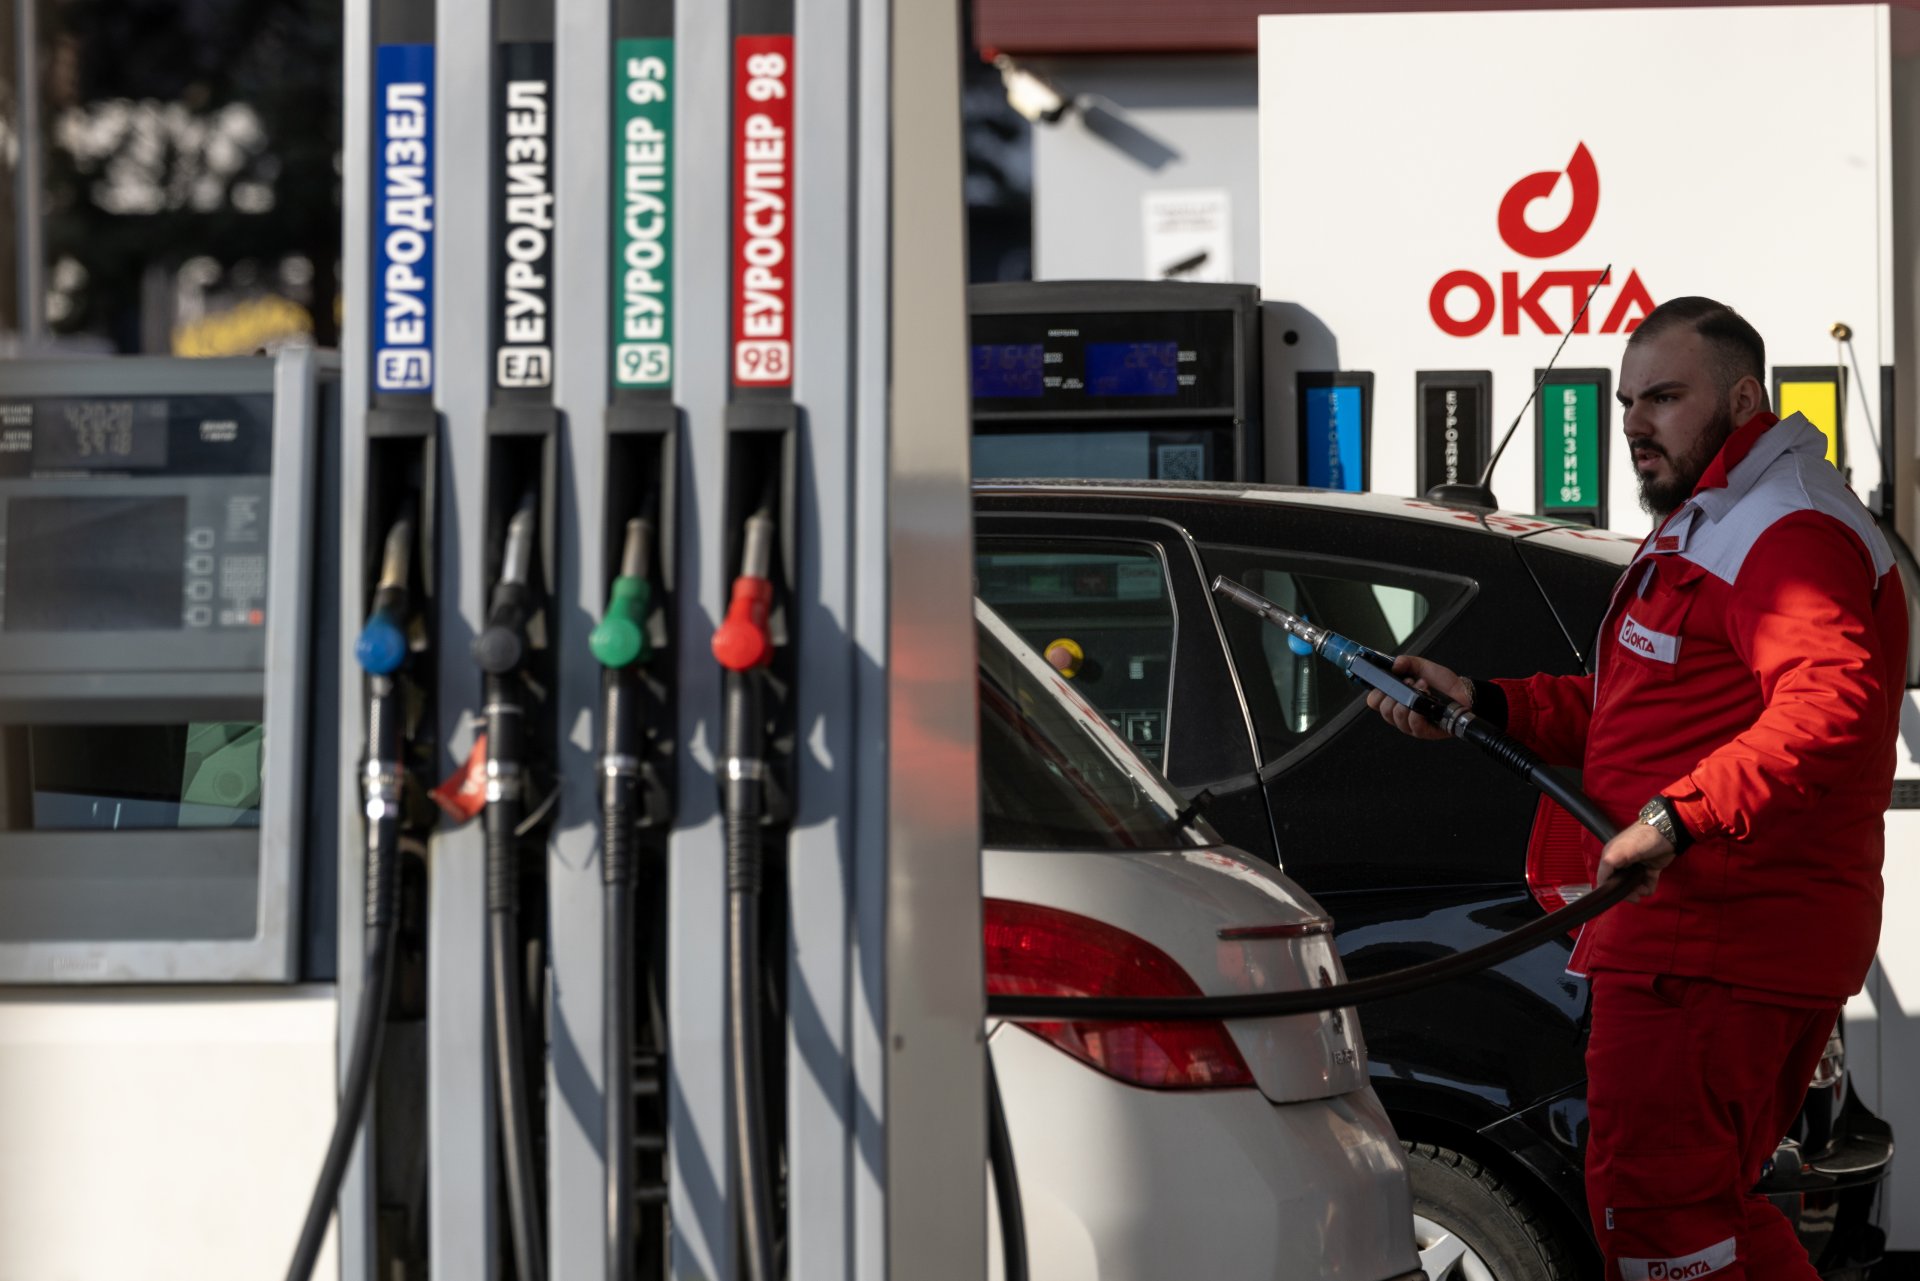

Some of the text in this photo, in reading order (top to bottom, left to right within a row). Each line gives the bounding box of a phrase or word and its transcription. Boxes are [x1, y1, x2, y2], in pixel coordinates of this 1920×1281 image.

[624, 56, 665, 339] ЕУРОСУПЕР 95
[744, 52, 786, 337] ЕУРОСУПЕР 98
[386, 83, 432, 343] ЕУРОДИЗЕЛ
[506, 81, 552, 342] ЕУРОДИЗЕЛ
[386, 357, 424, 387] ЕД
[505, 355, 545, 385] ЕД
[624, 349, 664, 377] 95
[743, 347, 783, 374] 98
[1560, 389, 1581, 502] БЕНЗИН 95
[1631, 633, 1655, 654] OKTA
[1670, 1261, 1711, 1280] OKTA
